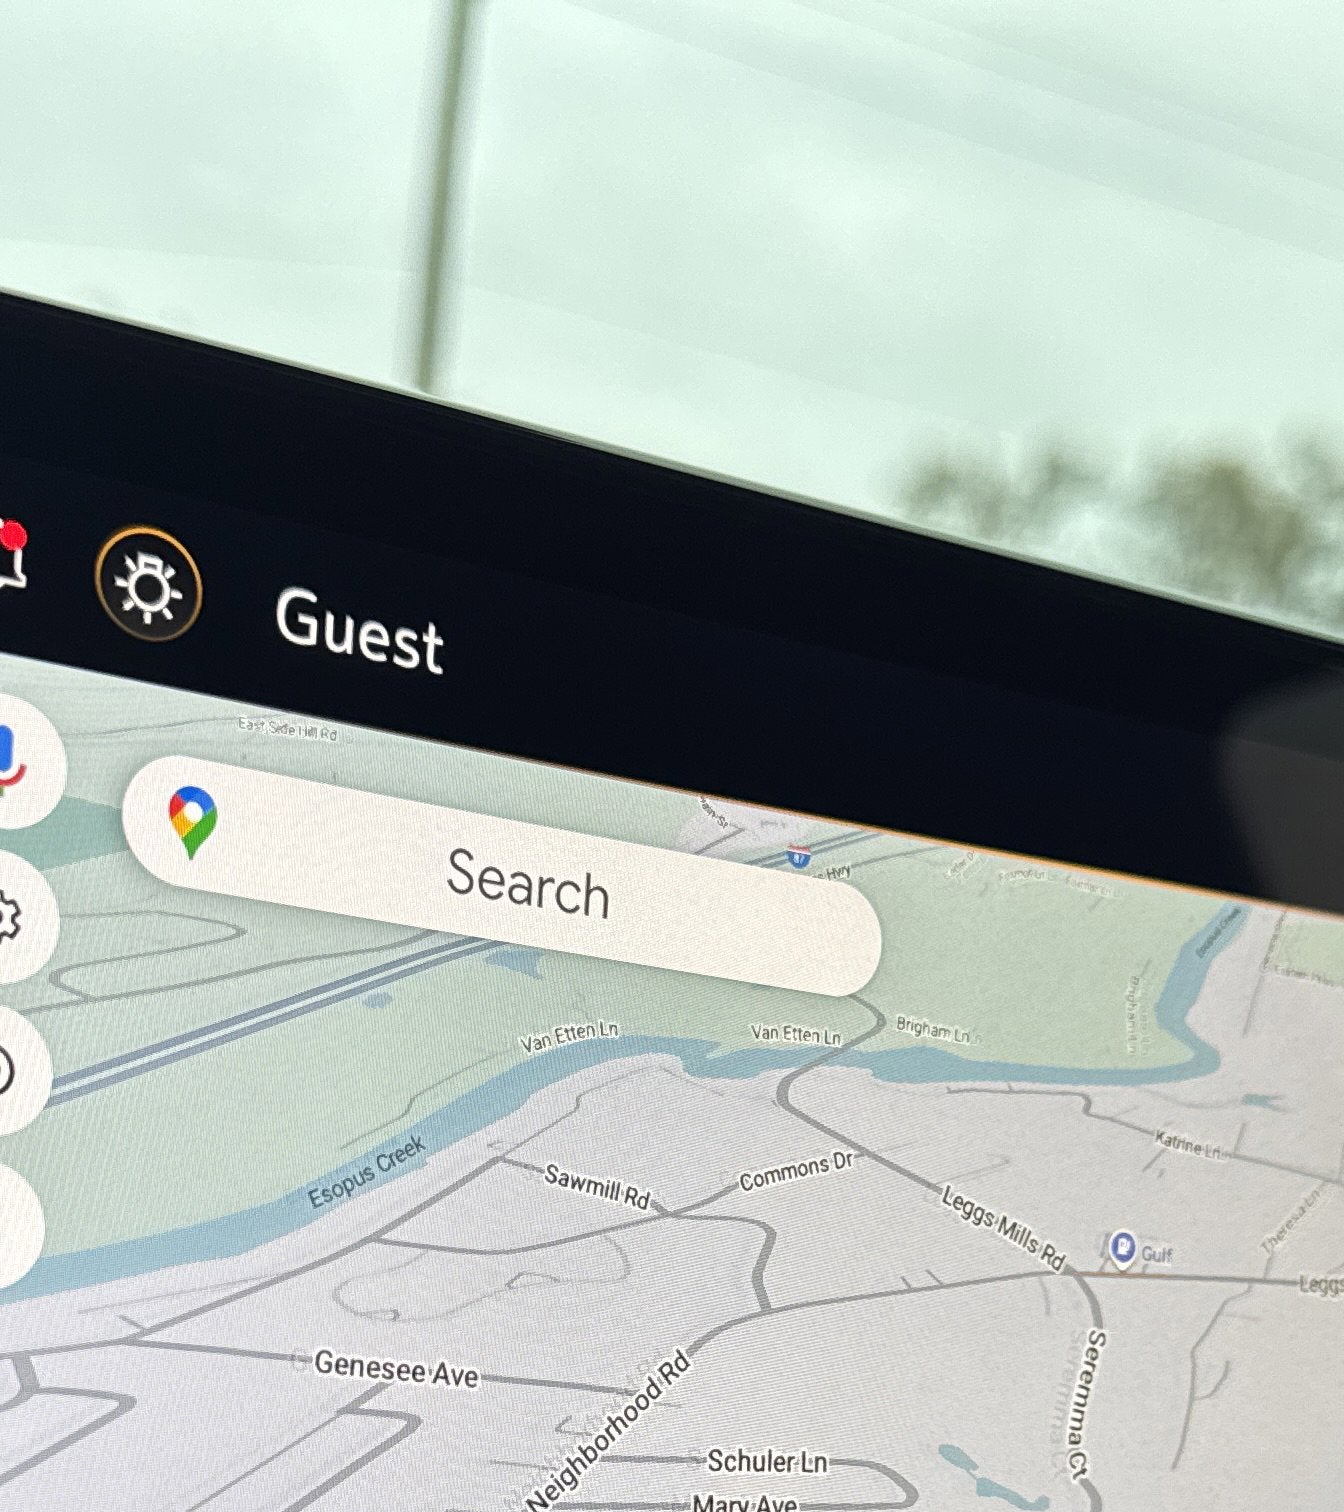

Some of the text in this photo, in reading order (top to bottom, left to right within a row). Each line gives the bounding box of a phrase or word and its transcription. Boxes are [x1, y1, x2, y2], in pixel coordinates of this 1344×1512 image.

[276, 586, 445, 676] Guest
[447, 848, 611, 920] Search
[520, 1020, 619, 1053] Van Etten Ln
[751, 1024, 841, 1046] Van Etten Ln
[897, 1016, 969, 1043] Brigham Ln
[1155, 1129, 1202, 1156] Katrine
[307, 1134, 427, 1209] Esopus Creek
[542, 1163, 652, 1211] Sawmill Rd
[738, 1151, 856, 1192] Commons Dr
[942, 1185, 1067, 1272] Leggs Mills Rd
[1142, 1246, 1173, 1265] Gulf
[314, 1349, 479, 1389] Genesee Ave
[657, 1348, 692, 1387] Rd
[1068, 1329, 1107, 1482] Seremma Ct
[707, 1448, 829, 1474] Schuler Ln
